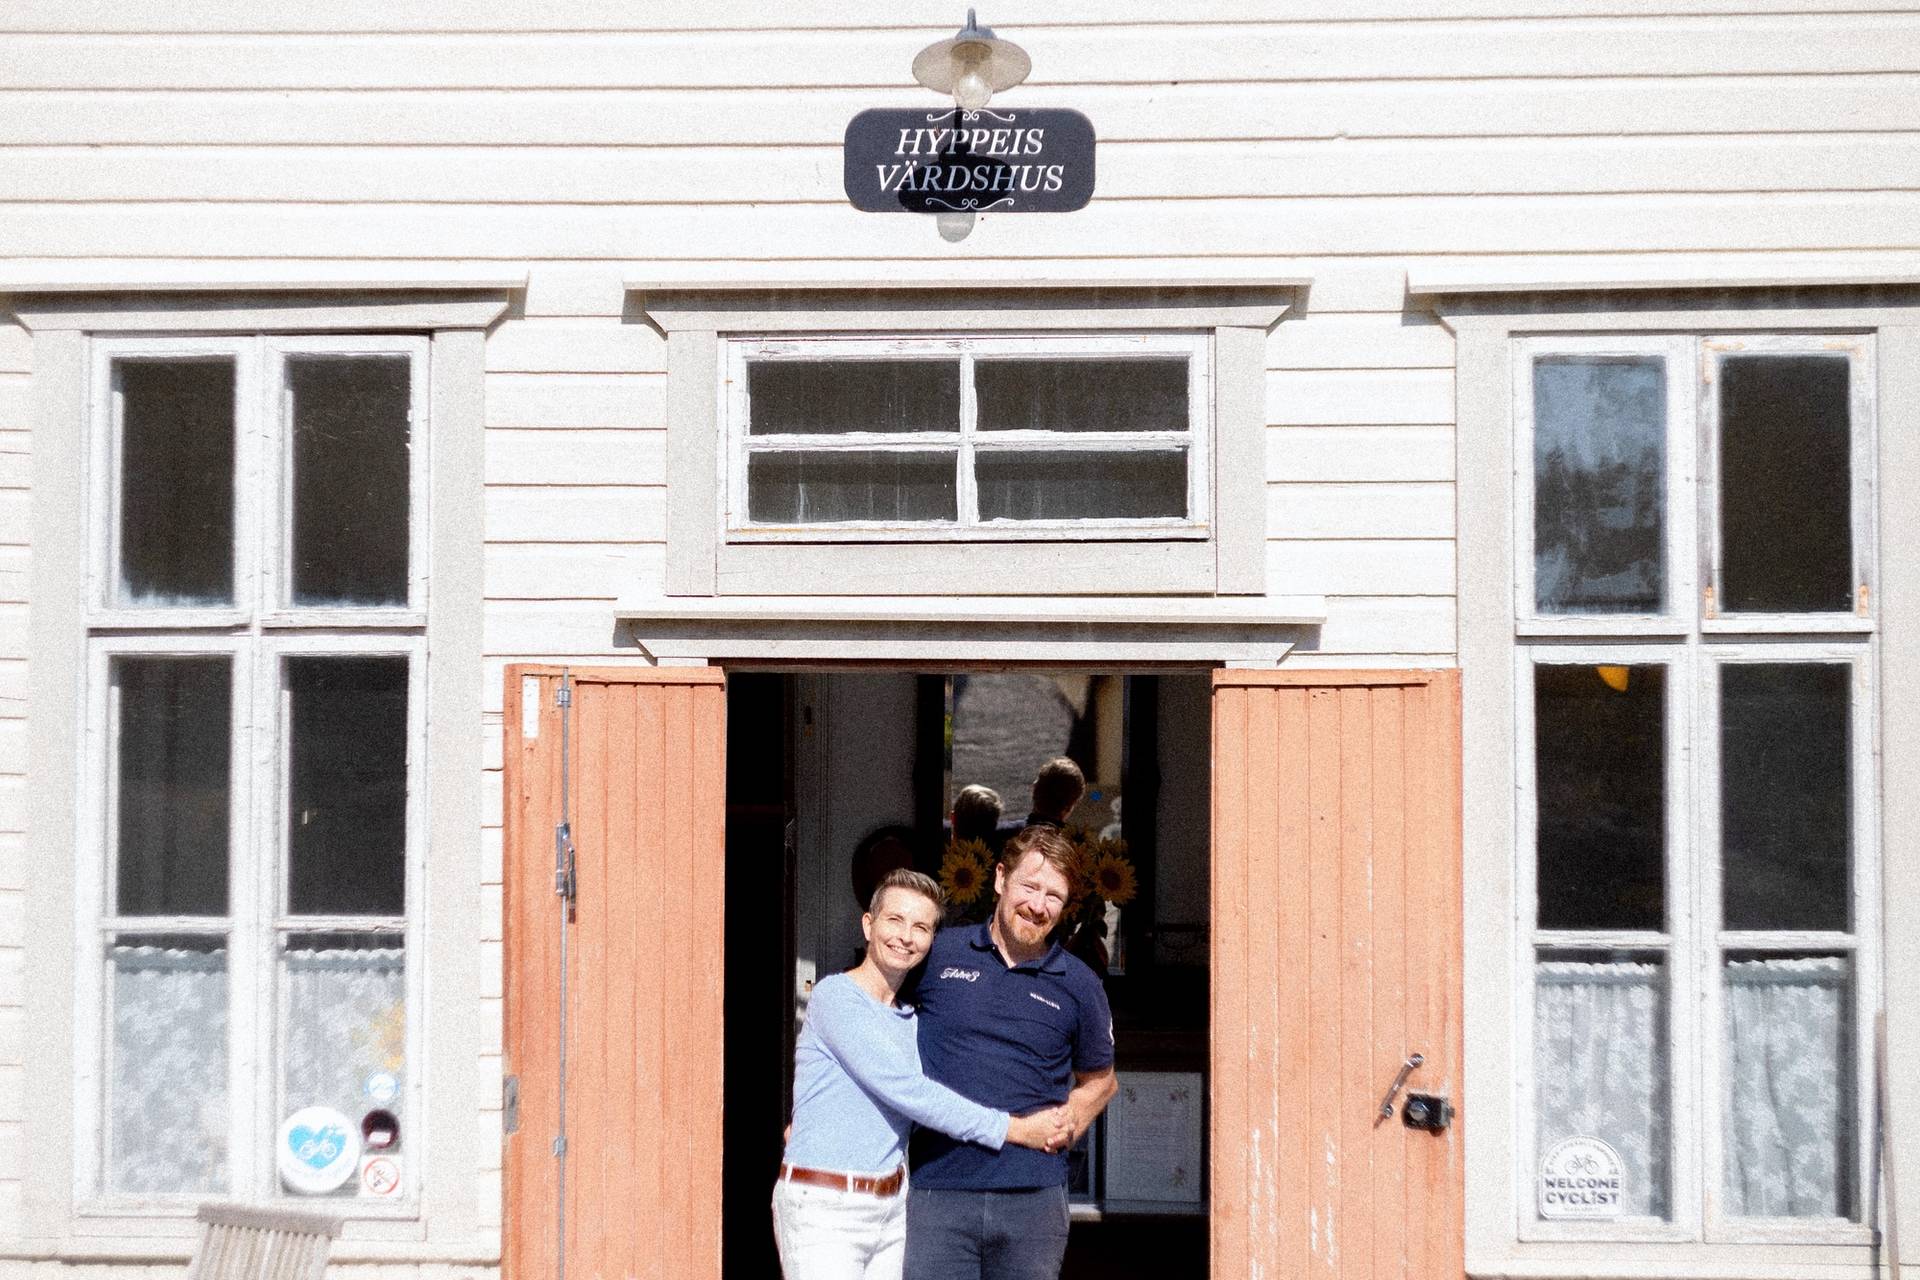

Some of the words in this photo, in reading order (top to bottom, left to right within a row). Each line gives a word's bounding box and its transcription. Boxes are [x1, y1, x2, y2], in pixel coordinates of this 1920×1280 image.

[894, 128, 1045, 155] HYPPEIS
[875, 160, 1065, 192] VÄRDSHUS
[1545, 1178, 1619, 1189] WELCOME
